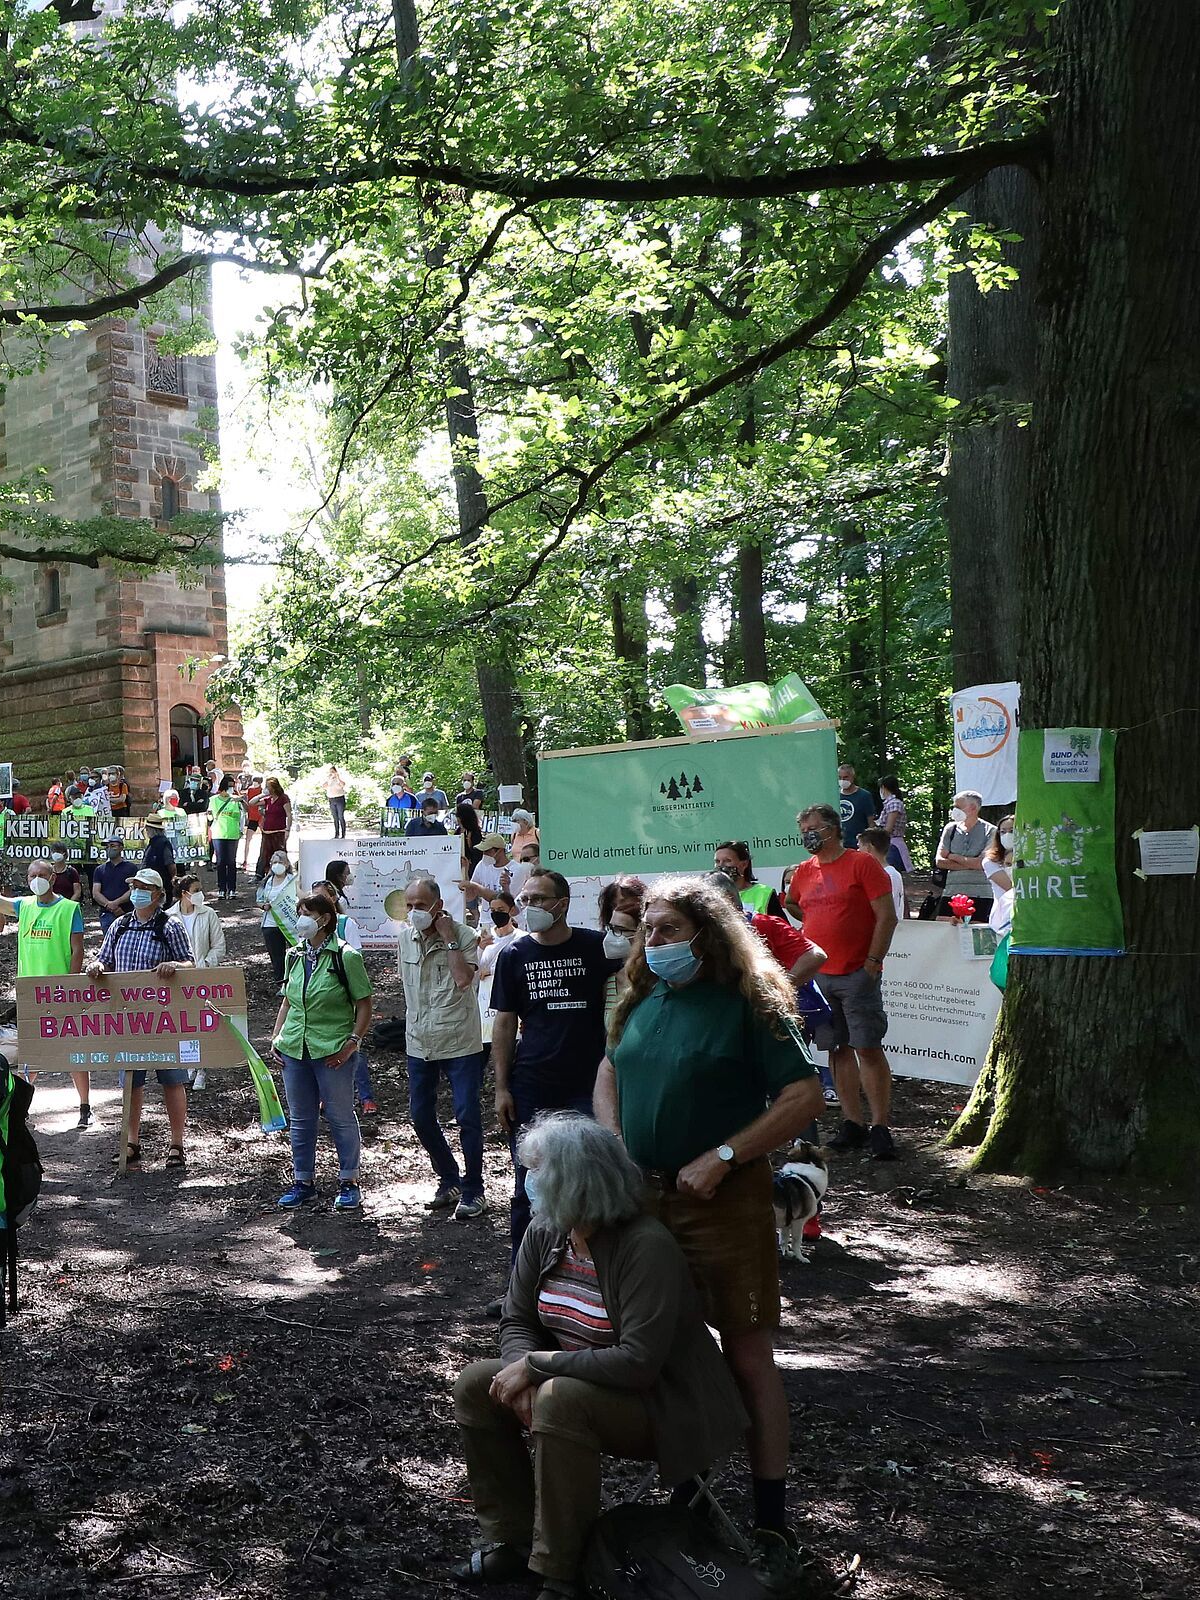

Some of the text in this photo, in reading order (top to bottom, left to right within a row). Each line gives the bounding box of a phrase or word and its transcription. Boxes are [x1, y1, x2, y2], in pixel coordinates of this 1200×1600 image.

[1051, 751, 1072, 759] BUND
[1056, 767, 1077, 775] Bayern
[383, 812, 401, 829] JA
[7, 820, 48, 838] KEIN
[60, 820, 145, 840] ICE-Werk
[357, 840, 407, 848] Bürgerinitiative
[548, 849, 568, 861] Der
[572, 847, 600, 860] Wald
[603, 845, 635, 858] atmet
[638, 843, 654, 856] für
[656, 844, 679, 856] uns,
[683, 840, 701, 852] wir
[752, 836, 772, 849] ihn
[775, 834, 804, 848] schü
[7, 845, 50, 858] 46000
[387, 849, 397, 857] bei
[1016, 875, 1088, 900] AHRE
[31, 930, 52, 938] NEIN!
[524, 958, 583, 971] 1N73LL1G3NC3
[536, 970, 552, 980] 7H3
[553, 967, 587, 978] 4B1L17Y
[537, 979, 562, 989] 4D4P7
[889, 980, 980, 996] von 460 000 m² Bannwald
[35, 983, 233, 1005] Hände weg vom
[538, 988, 572, 999] CH4NG3.
[890, 989, 903, 998] des
[904, 990, 976, 1007] Vogelschutzgebietes
[918, 1002, 987, 1020] Lichtverschmutzung
[39, 1009, 220, 1038] BANNWALD
[890, 1011, 969, 1027] unseres Grundwassers
[114, 1051, 177, 1064] Allersberg
[882, 1043, 976, 1065] ww.harrlach.com
